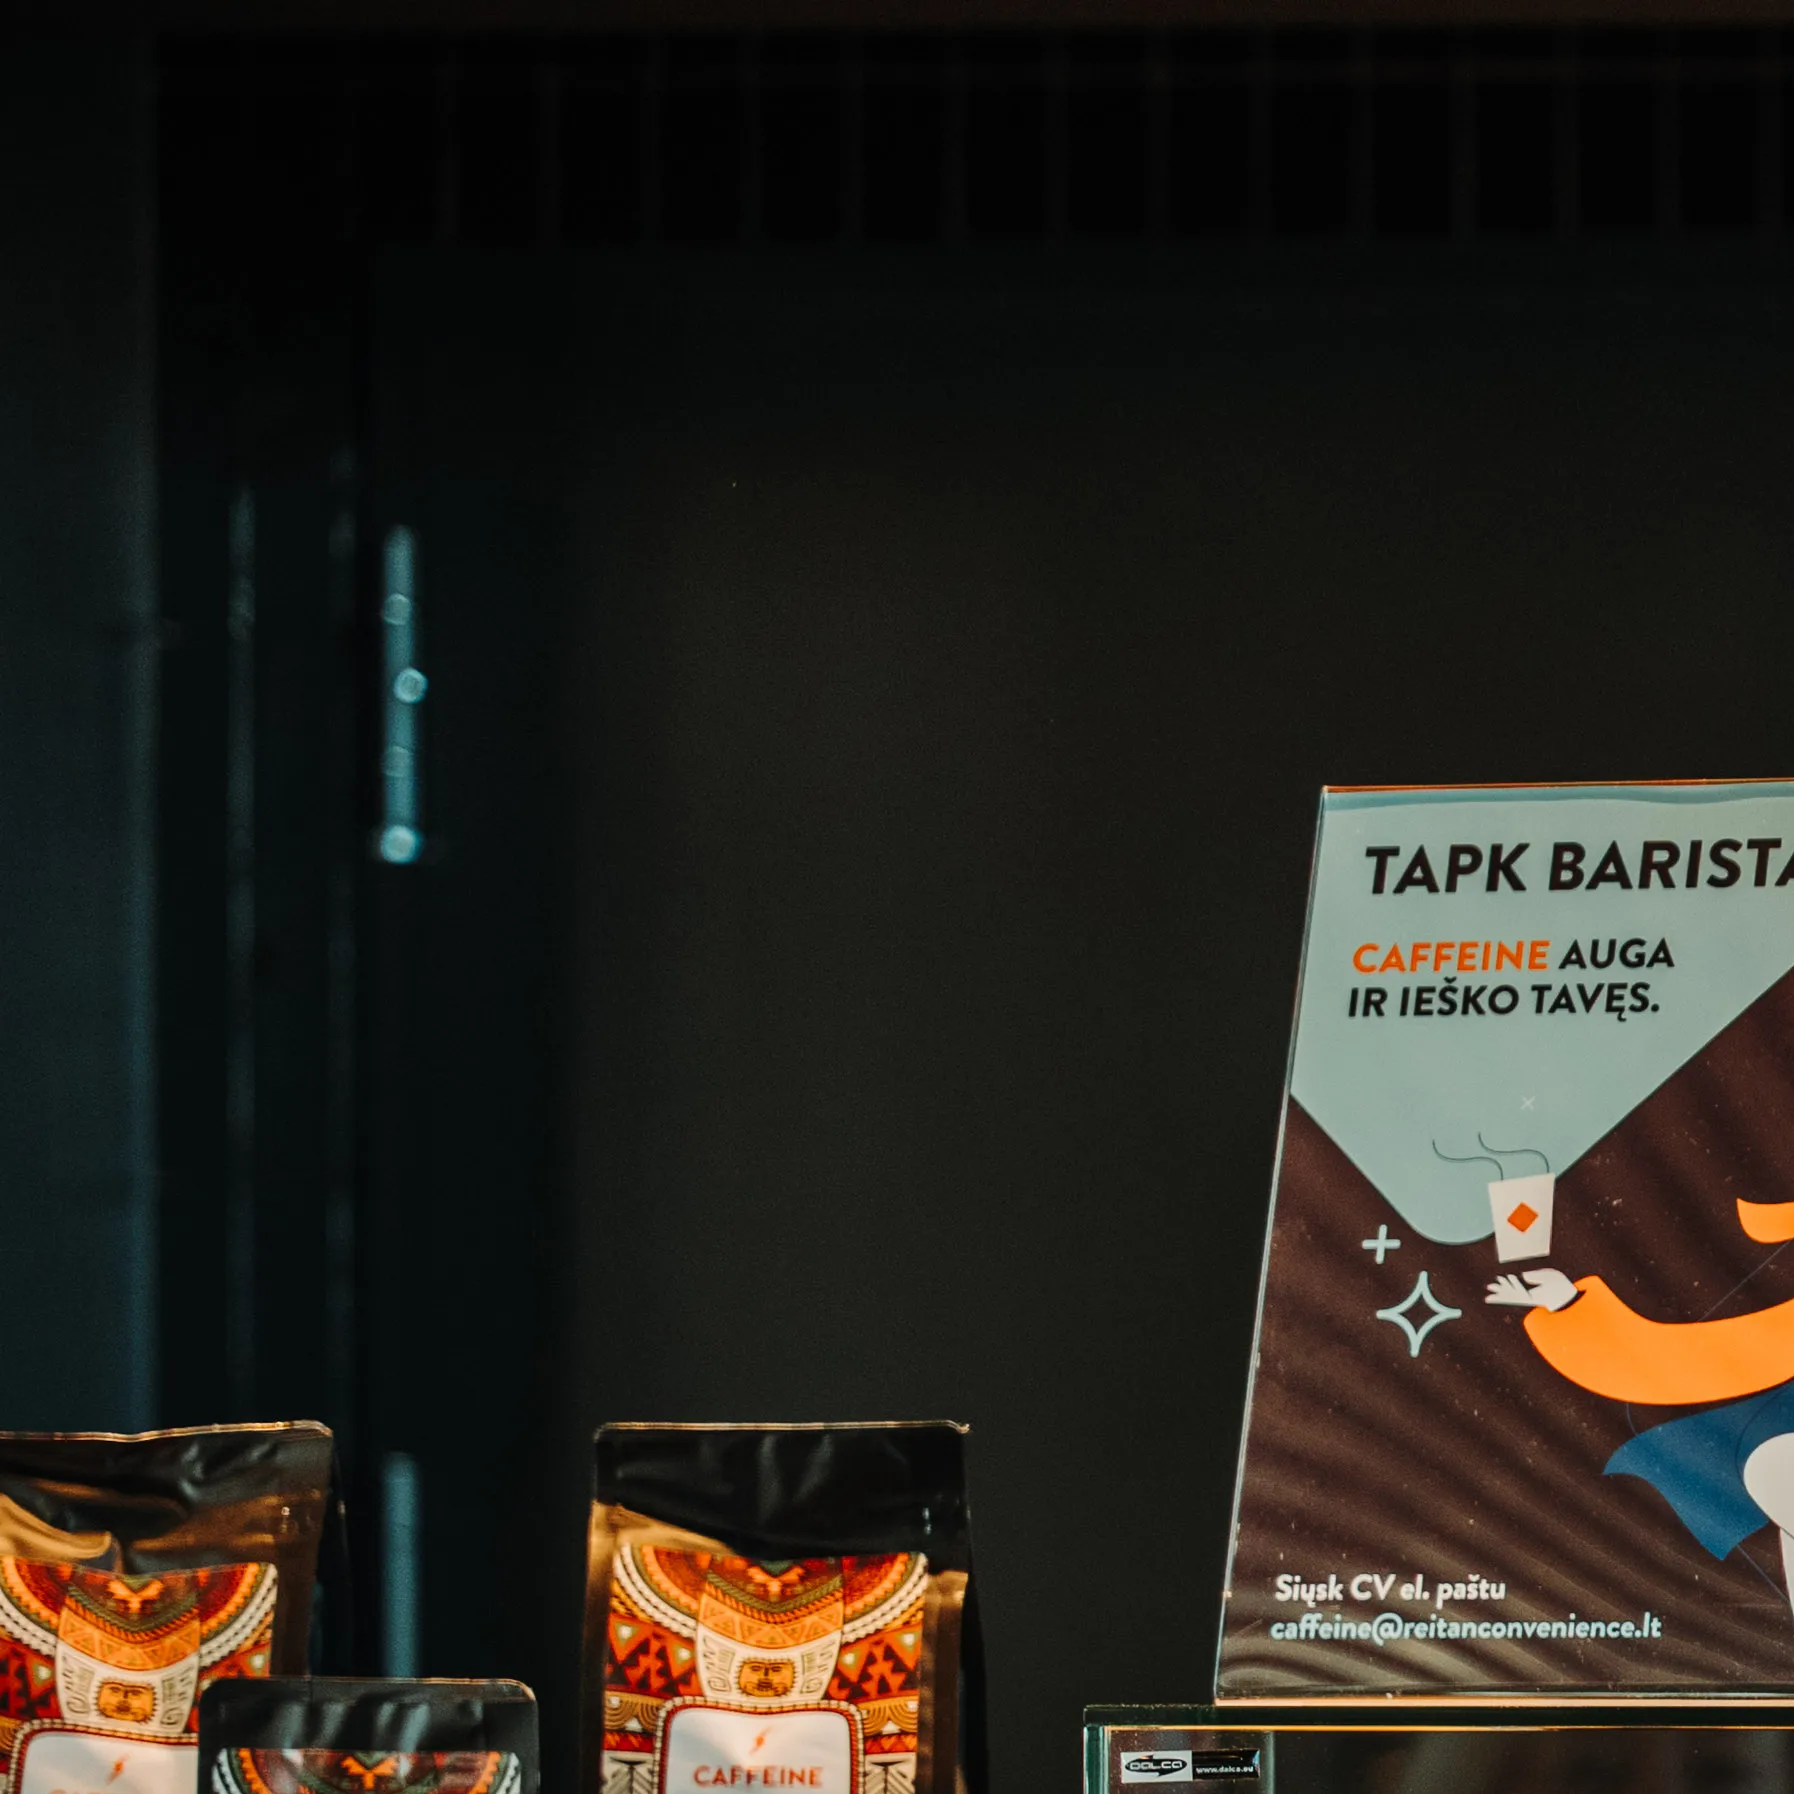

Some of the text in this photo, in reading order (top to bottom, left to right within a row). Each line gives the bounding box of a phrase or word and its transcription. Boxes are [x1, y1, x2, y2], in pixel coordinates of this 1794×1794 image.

[1364, 842, 1529, 896] TAPK
[1352, 937, 1676, 973] CAFFEINE AUGA
[1348, 977, 1660, 1022] IR IEŠKO TAVĘS.
[1275, 1574, 1507, 1604] Siųsk CV el. paštu
[1270, 1613, 1662, 1644] caffeine@reitanconvenience.lt
[693, 1764, 823, 1788] CAFFEINE
